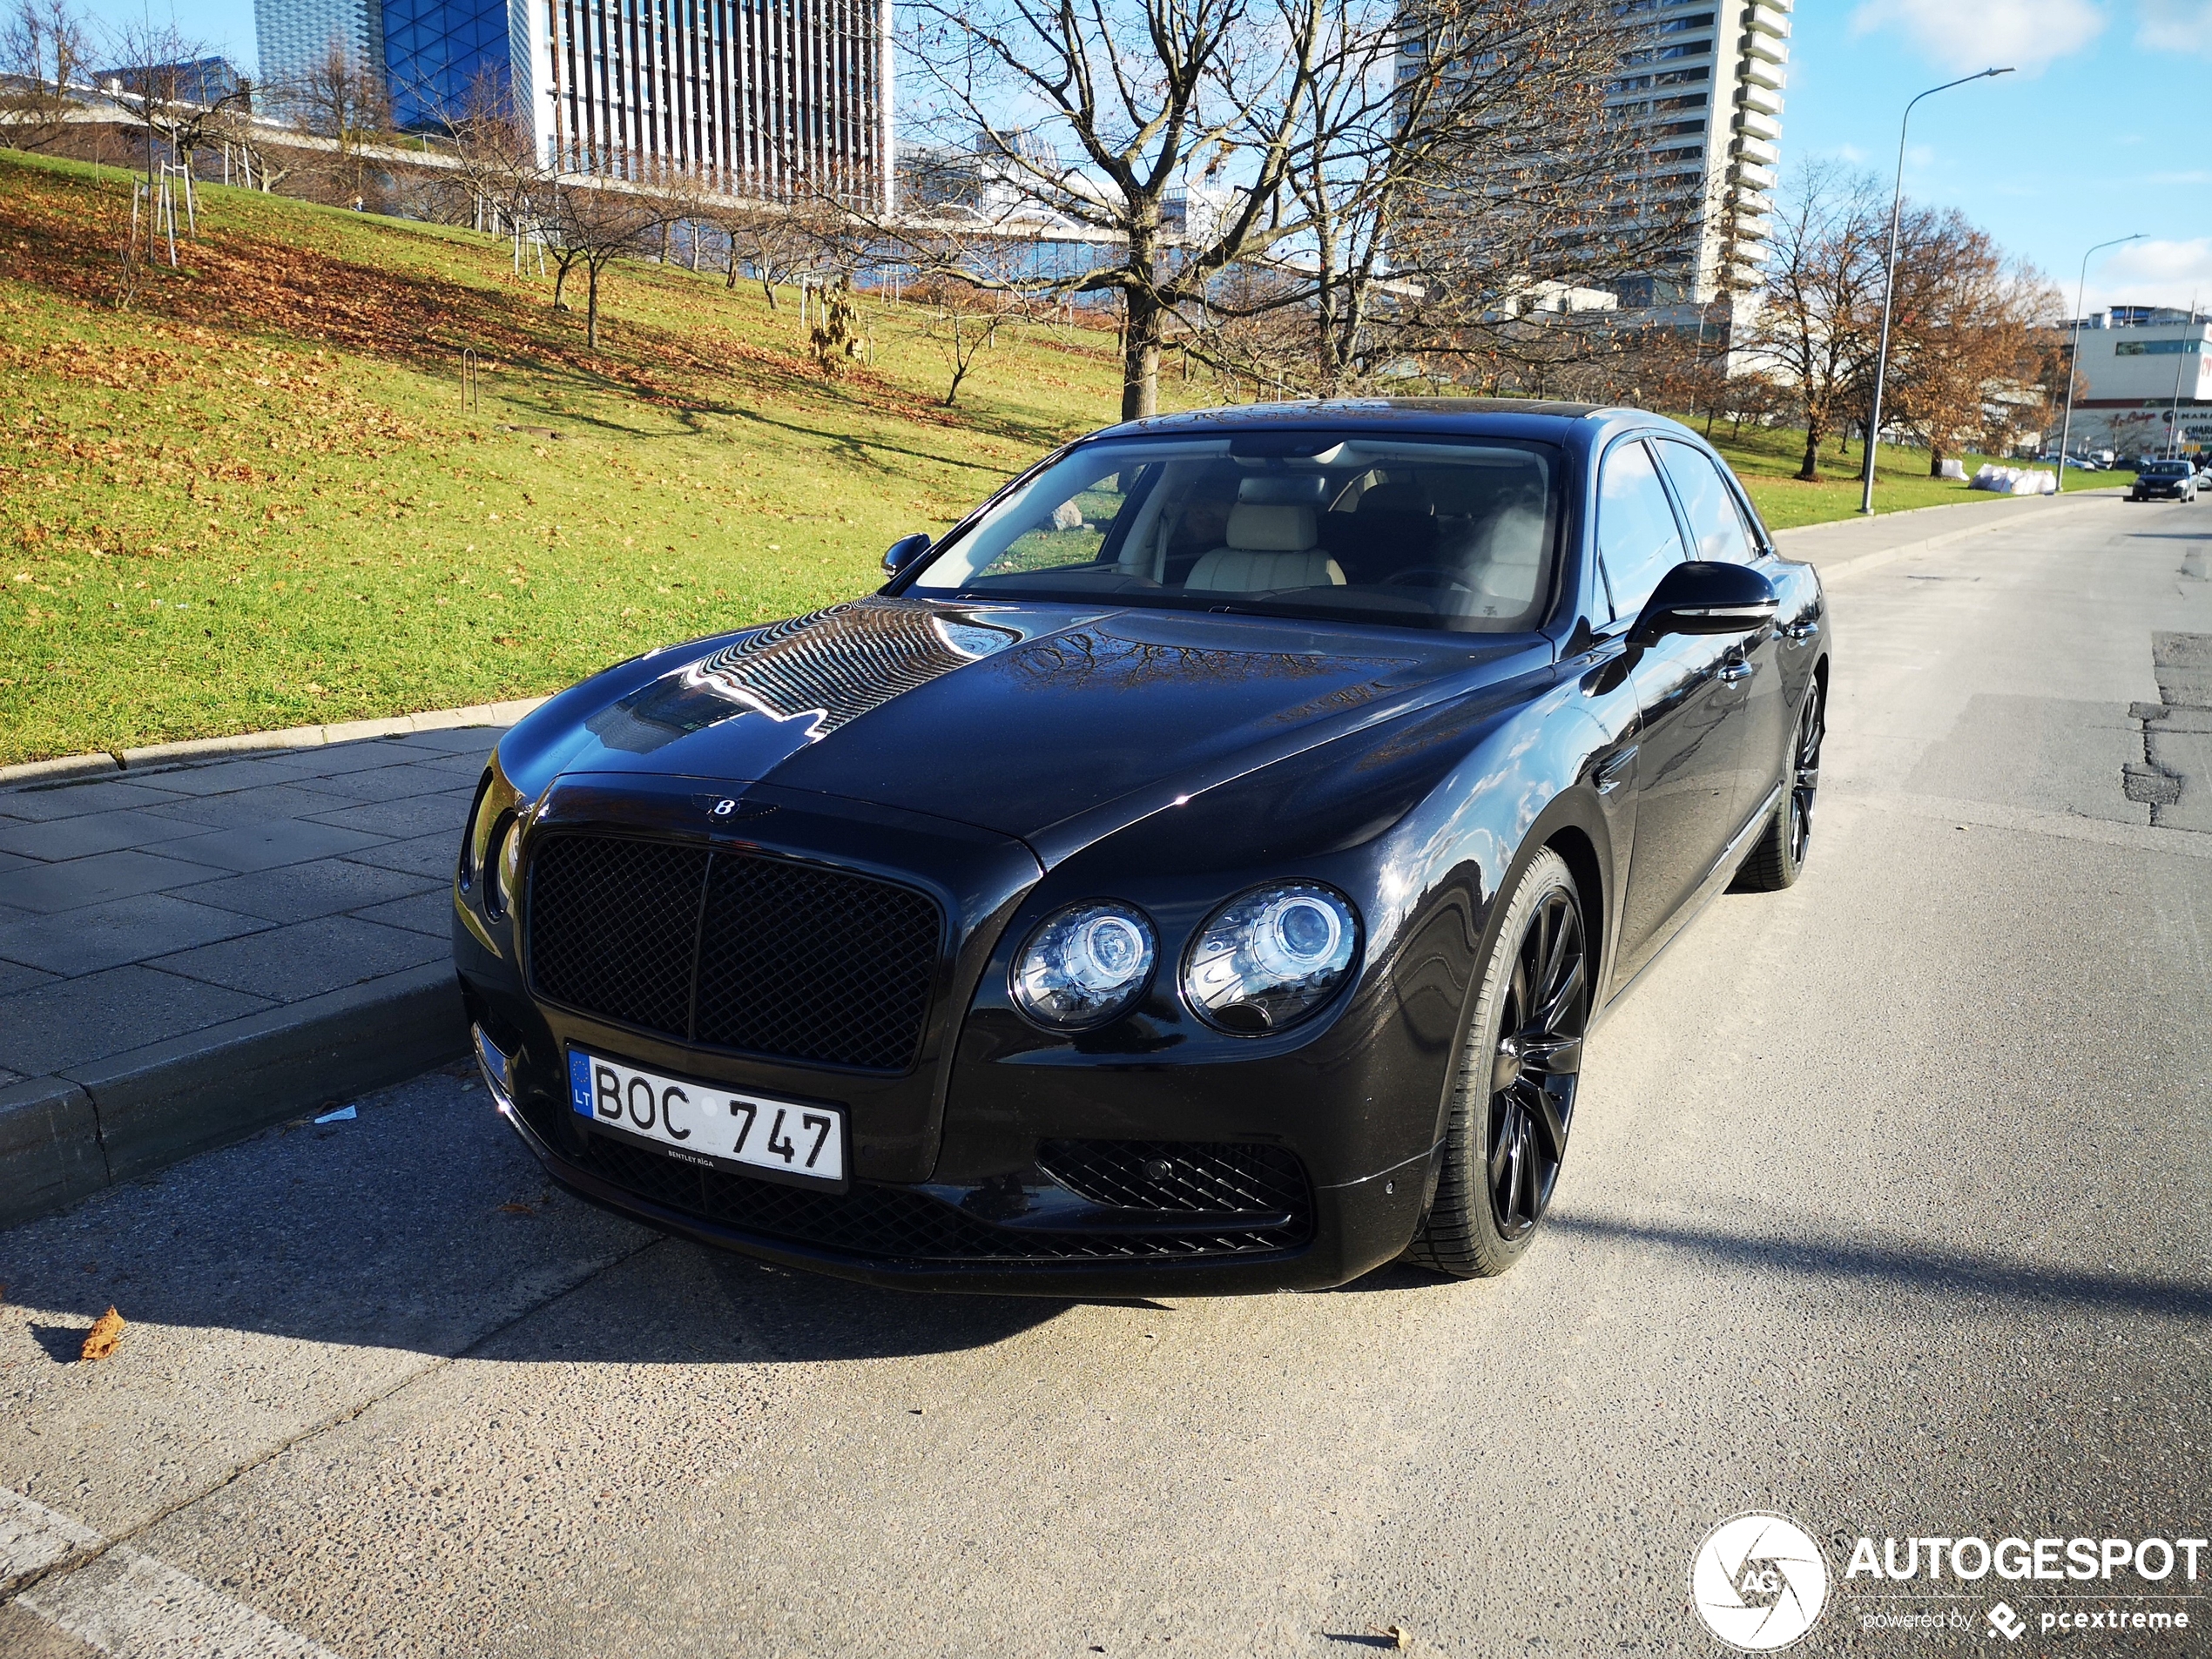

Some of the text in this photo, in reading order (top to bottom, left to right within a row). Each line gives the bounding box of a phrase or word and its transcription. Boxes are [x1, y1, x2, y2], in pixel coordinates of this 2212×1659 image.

[713, 799, 736, 815] B
[575, 1089, 590, 1106] LT
[595, 1063, 831, 1168] BOC 747
[668, 1150, 697, 1163] BENTLEY
